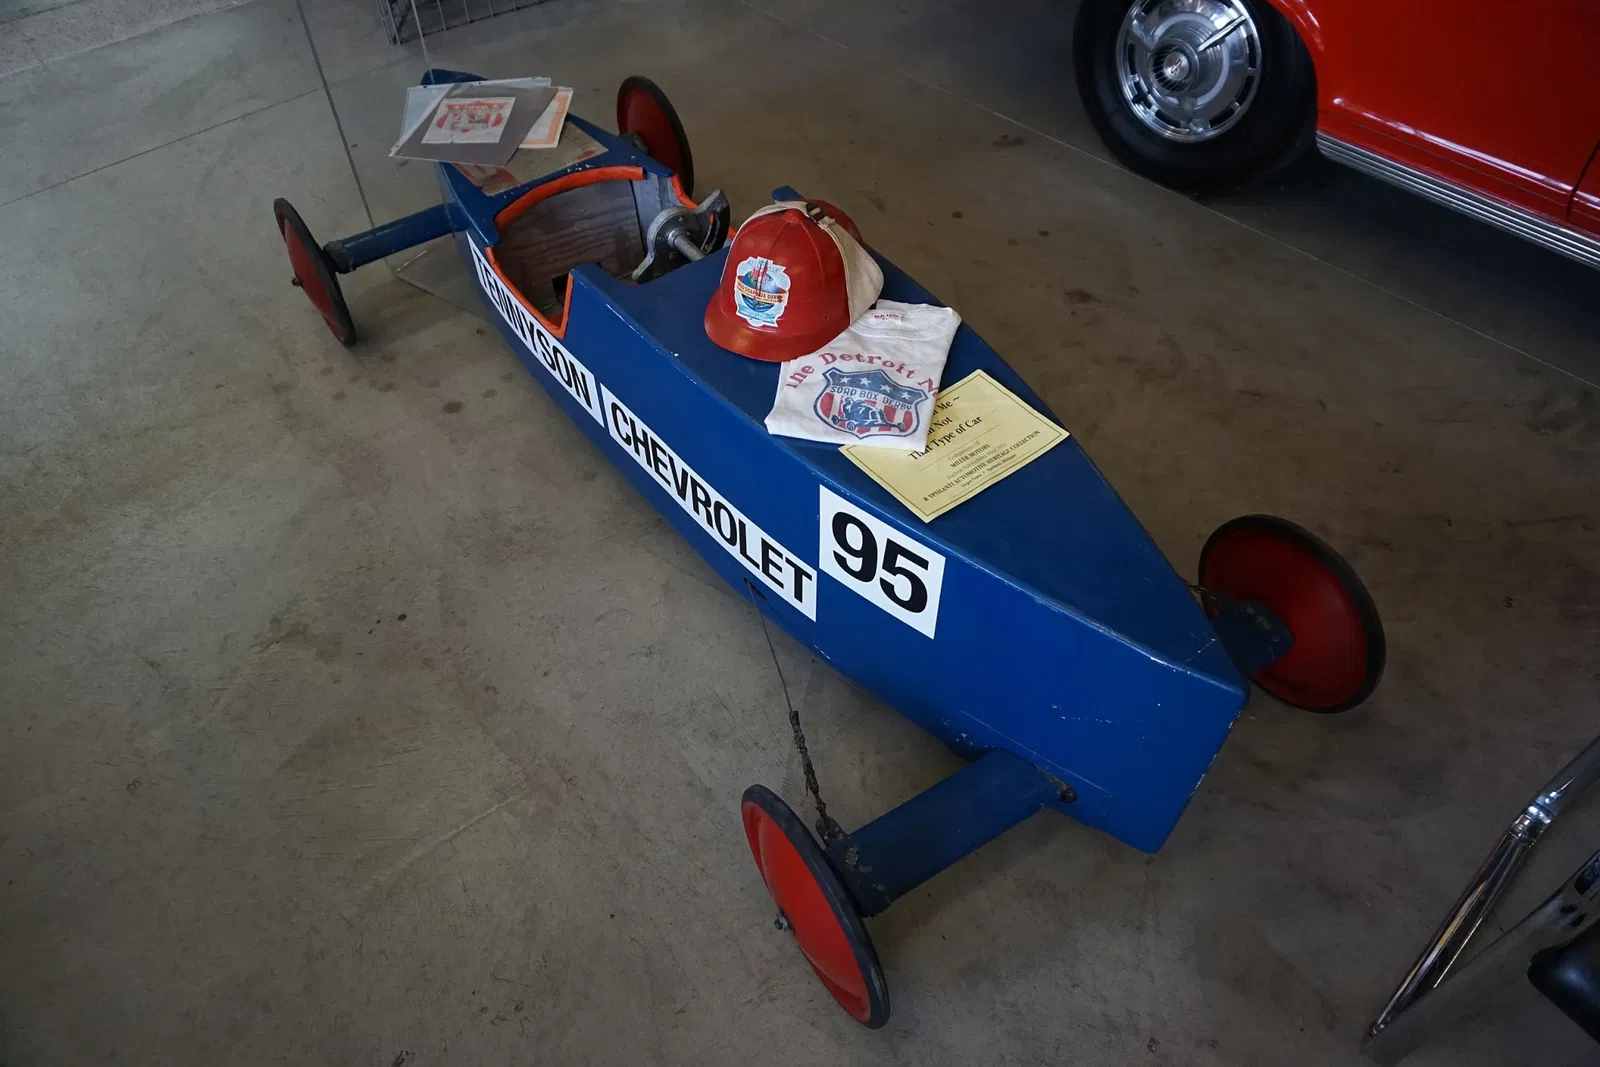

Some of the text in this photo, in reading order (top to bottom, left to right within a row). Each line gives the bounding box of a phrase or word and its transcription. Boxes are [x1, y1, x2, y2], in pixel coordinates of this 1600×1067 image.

[818, 352, 916, 379] Detroit
[830, 386, 913, 411] SOAP BOX DERBY
[937, 401, 953, 412] Me
[472, 247, 813, 604] TENNYSON CHEVROLET
[933, 416, 953, 429] Not
[908, 445, 933, 460] That
[930, 431, 956, 447] Type
[955, 423, 967, 434] of
[965, 416, 982, 428] Car
[928, 482, 955, 499] YPSILANTI
[954, 462, 987, 485] AUTOMOTIVE
[986, 448, 1011, 465] HERITAGE
[1010, 430, 1041, 451] COLLECTION
[950, 444, 991, 468] MILLER MOTORS
[831, 511, 930, 614] 95
